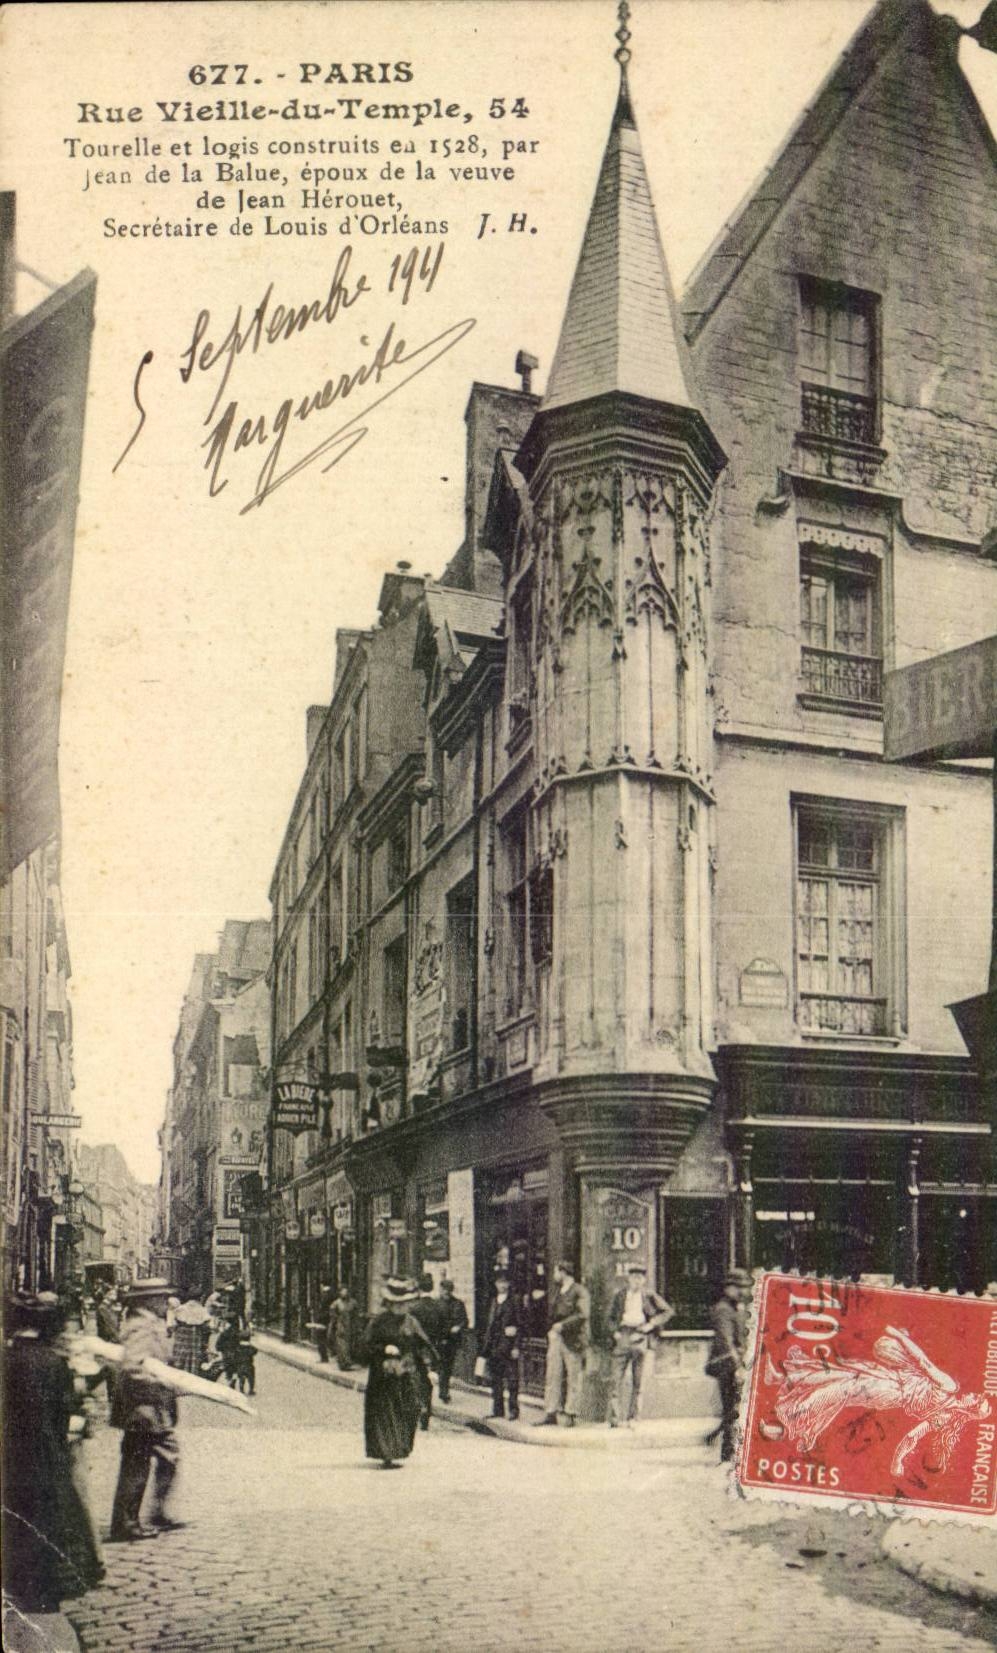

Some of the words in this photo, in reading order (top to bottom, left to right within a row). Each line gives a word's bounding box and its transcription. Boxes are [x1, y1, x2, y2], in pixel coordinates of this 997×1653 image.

[180, 246, 371, 425] Septembre
[201, 320, 430, 512] Marguerite
[757, 1457, 840, 1487] POSTES
[970, 1422, 995, 1505] FRANÇAISE
